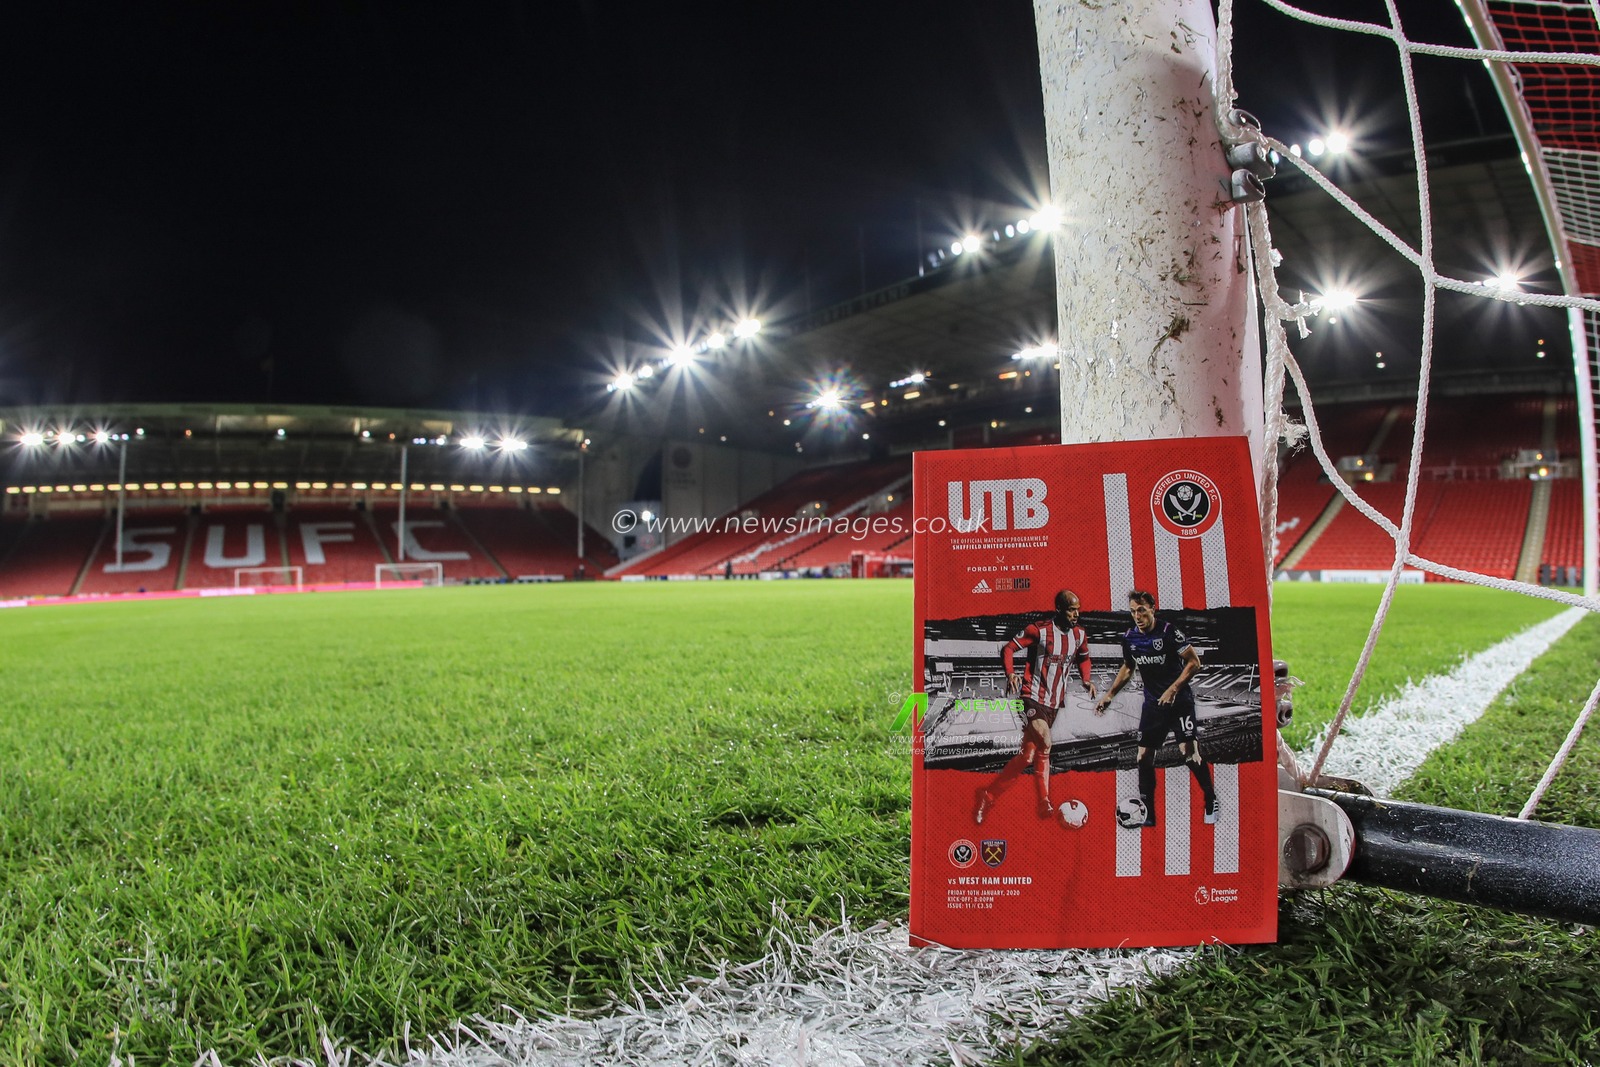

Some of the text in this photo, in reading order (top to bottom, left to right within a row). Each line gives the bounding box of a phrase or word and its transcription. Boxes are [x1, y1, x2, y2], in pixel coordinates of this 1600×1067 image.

[1154, 473, 1182, 506] SHEFFIELD
[1183, 472, 1211, 489] UNITED
[947, 477, 1050, 532] UTB
[1181, 528, 1198, 536] 1889
[1179, 715, 1195, 732] 16
[958, 877, 980, 885] WEST
[981, 877, 1000, 885] HAM
[1002, 876, 1033, 885] UNITED
[1211, 887, 1239, 896] Premier
[1211, 895, 1239, 904] League
